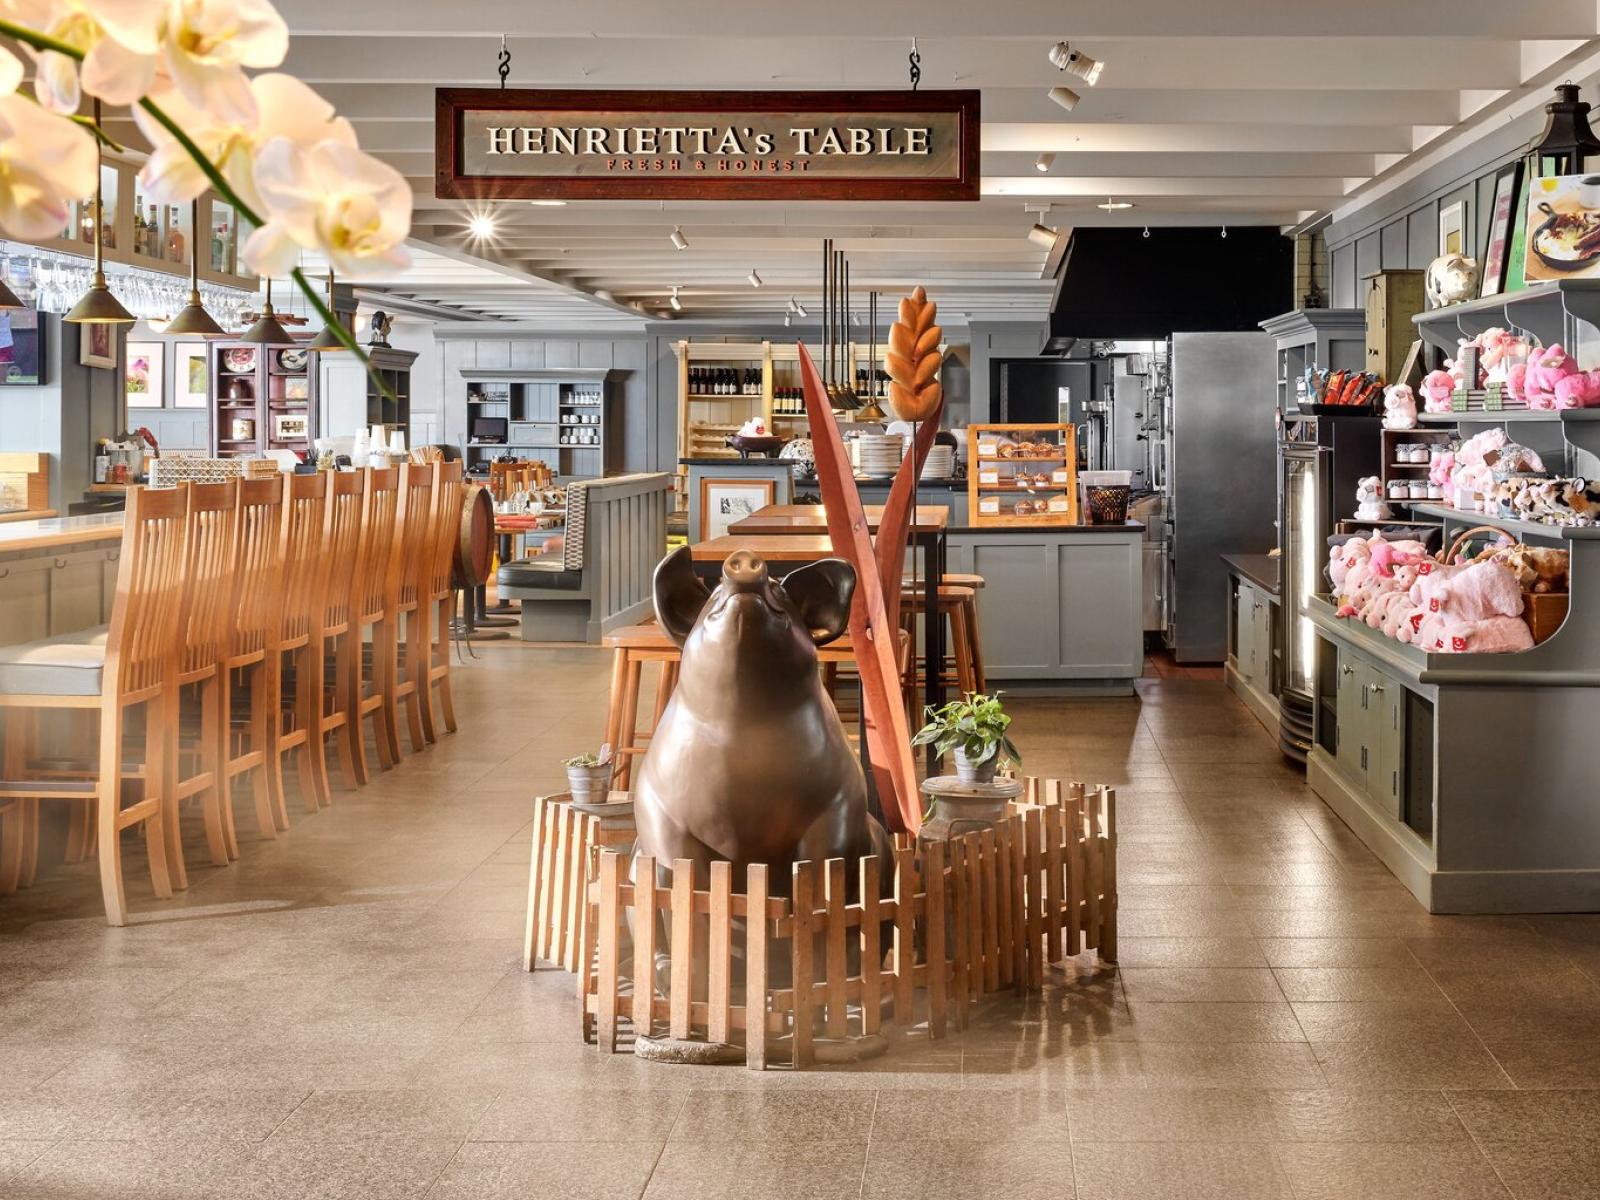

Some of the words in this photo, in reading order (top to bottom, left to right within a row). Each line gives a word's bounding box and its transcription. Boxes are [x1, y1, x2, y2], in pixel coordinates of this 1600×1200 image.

[486, 126, 775, 156] HENRIETTA's
[790, 126, 931, 156] TABLE
[607, 159, 681, 171] FRESH
[695, 159, 706, 171] &
[717, 159, 811, 172] HONEST
